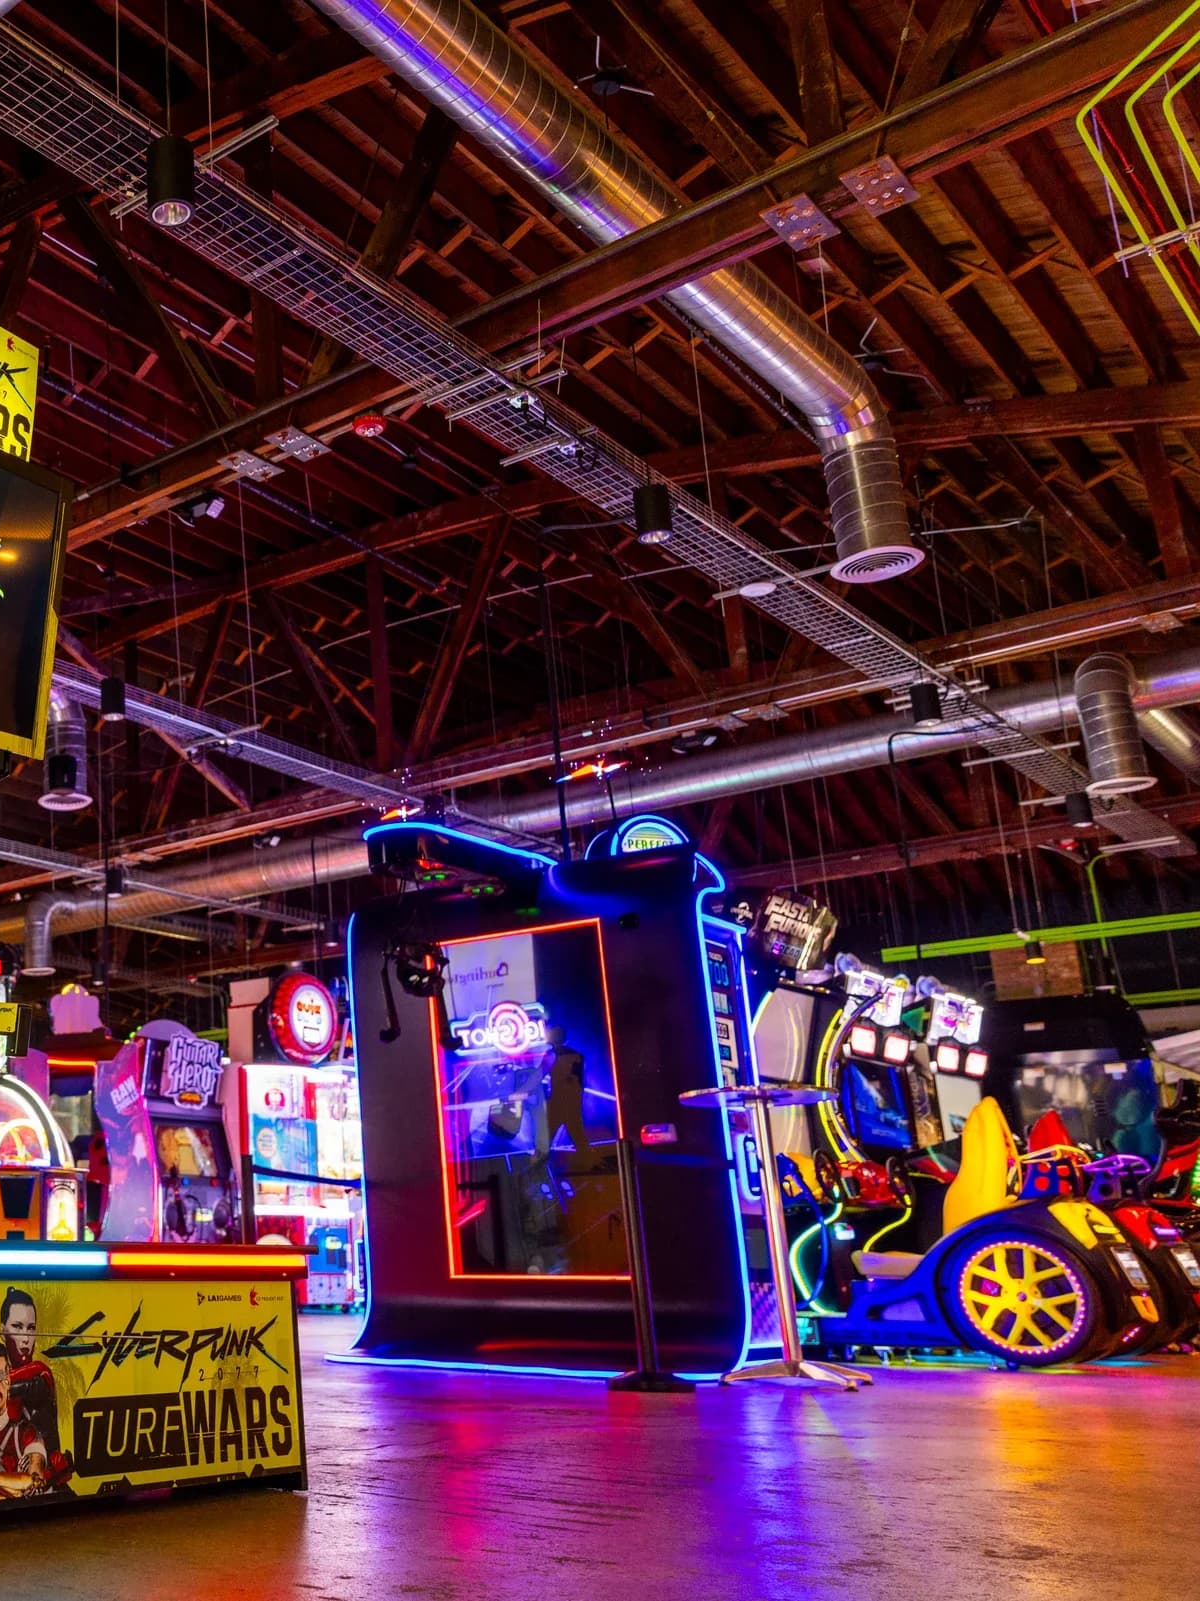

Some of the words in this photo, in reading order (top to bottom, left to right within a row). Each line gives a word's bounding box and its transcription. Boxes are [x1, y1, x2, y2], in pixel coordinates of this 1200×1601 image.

[628, 839, 673, 849] PERFEC
[170, 1035, 221, 1070] GUITAR
[168, 1060, 216, 1095] HERO
[199, 1366, 259, 1381] 2077
[82, 1406, 182, 1460] TURF
[180, 1385, 293, 1466] WARS
